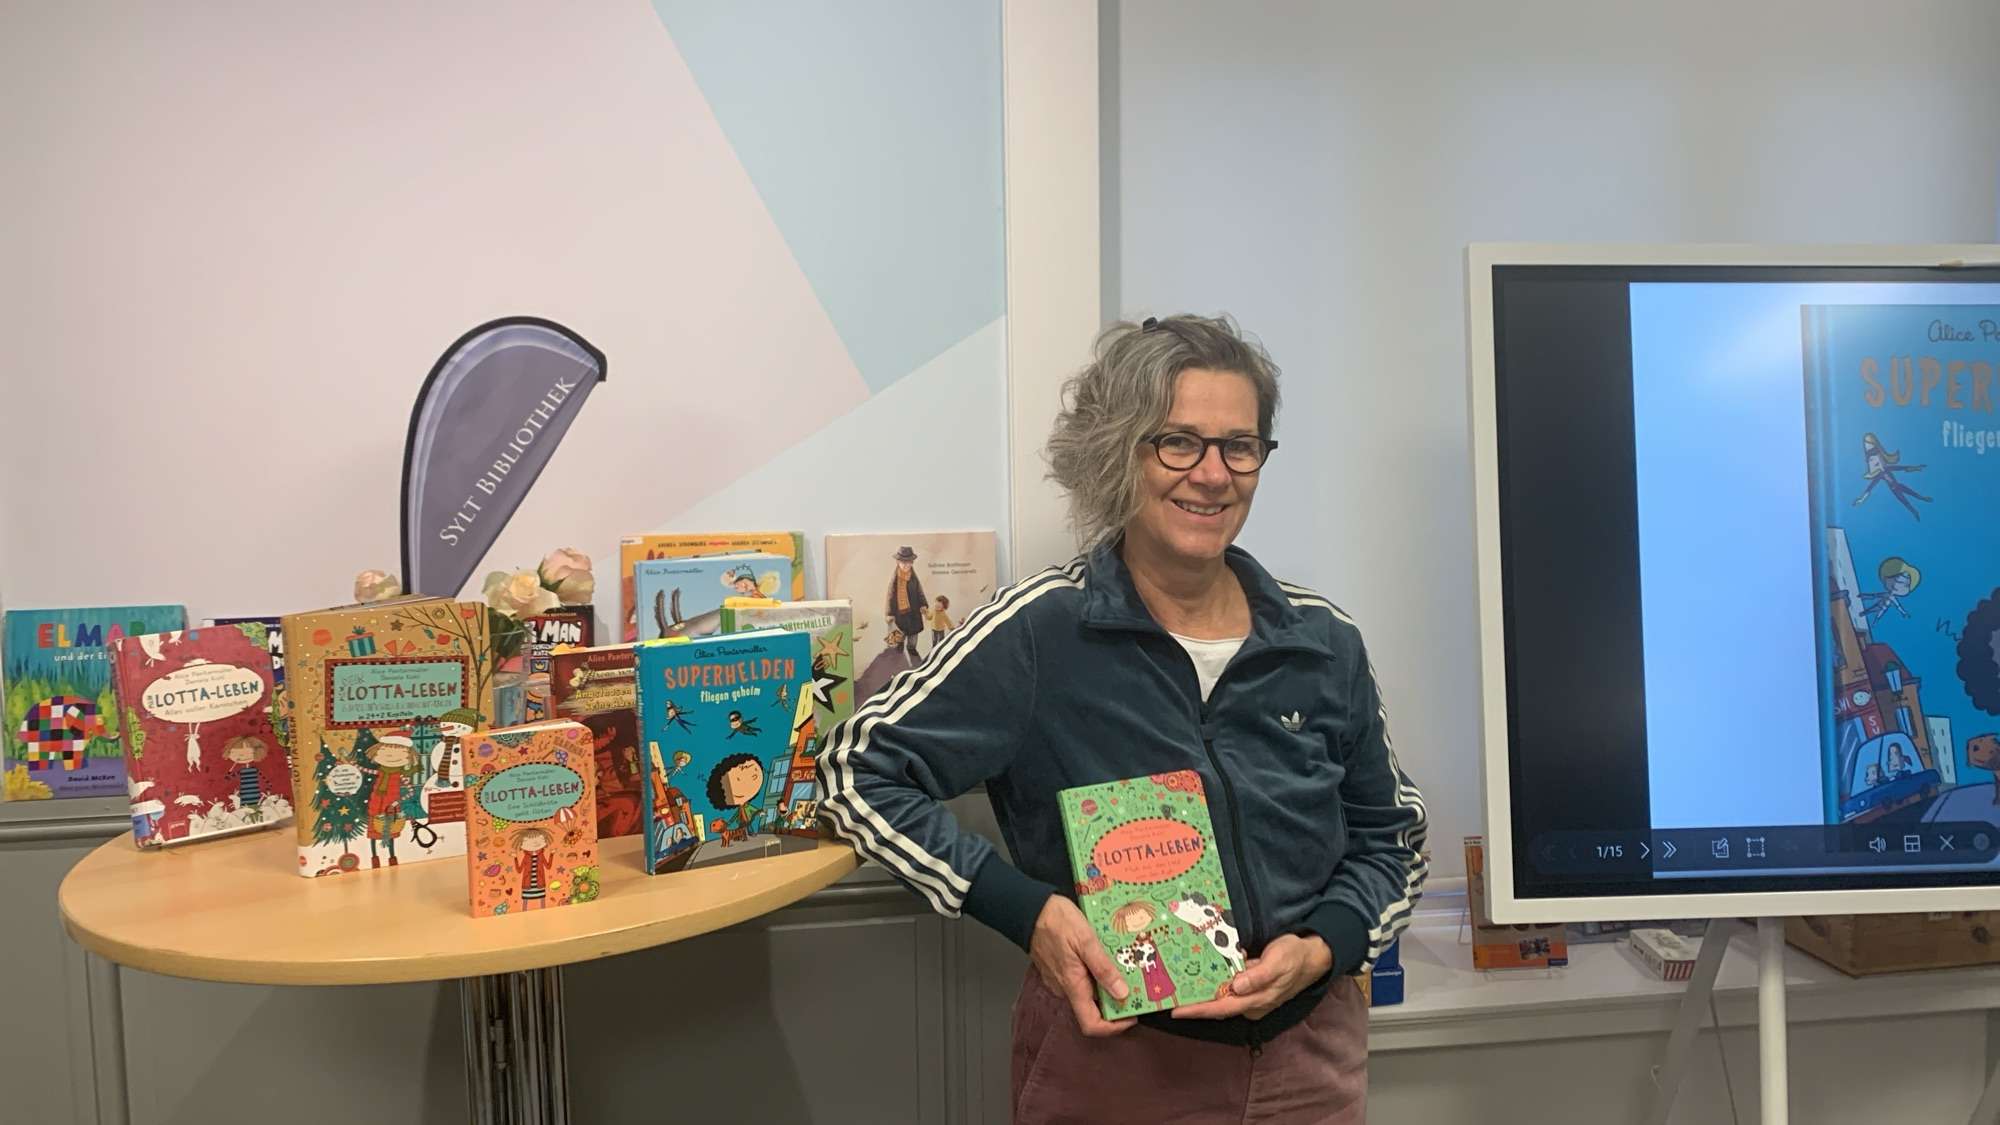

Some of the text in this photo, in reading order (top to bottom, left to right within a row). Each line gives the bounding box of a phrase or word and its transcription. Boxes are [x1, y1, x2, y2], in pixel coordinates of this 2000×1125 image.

[1928, 319, 1975, 342] Alice
[1861, 354, 2000, 415] SUPER
[439, 376, 577, 546] SYLT BIBLIOTHEK
[541, 620, 582, 643] MAN
[54, 651, 74, 662] und
[77, 651, 95, 661] der
[694, 647, 715, 659] Alice
[664, 657, 795, 689] SUPERHELDEN
[155, 680, 259, 708] LOTTA-LEBEN
[347, 681, 457, 701] LOTTA-LEBEN
[700, 685, 761, 704] fliegen geheim
[491, 781, 580, 803] LOTTA-LEBEN
[1104, 837, 1201, 866] LOTTA-LEBEN
[1595, 845, 1623, 859] 1/15
